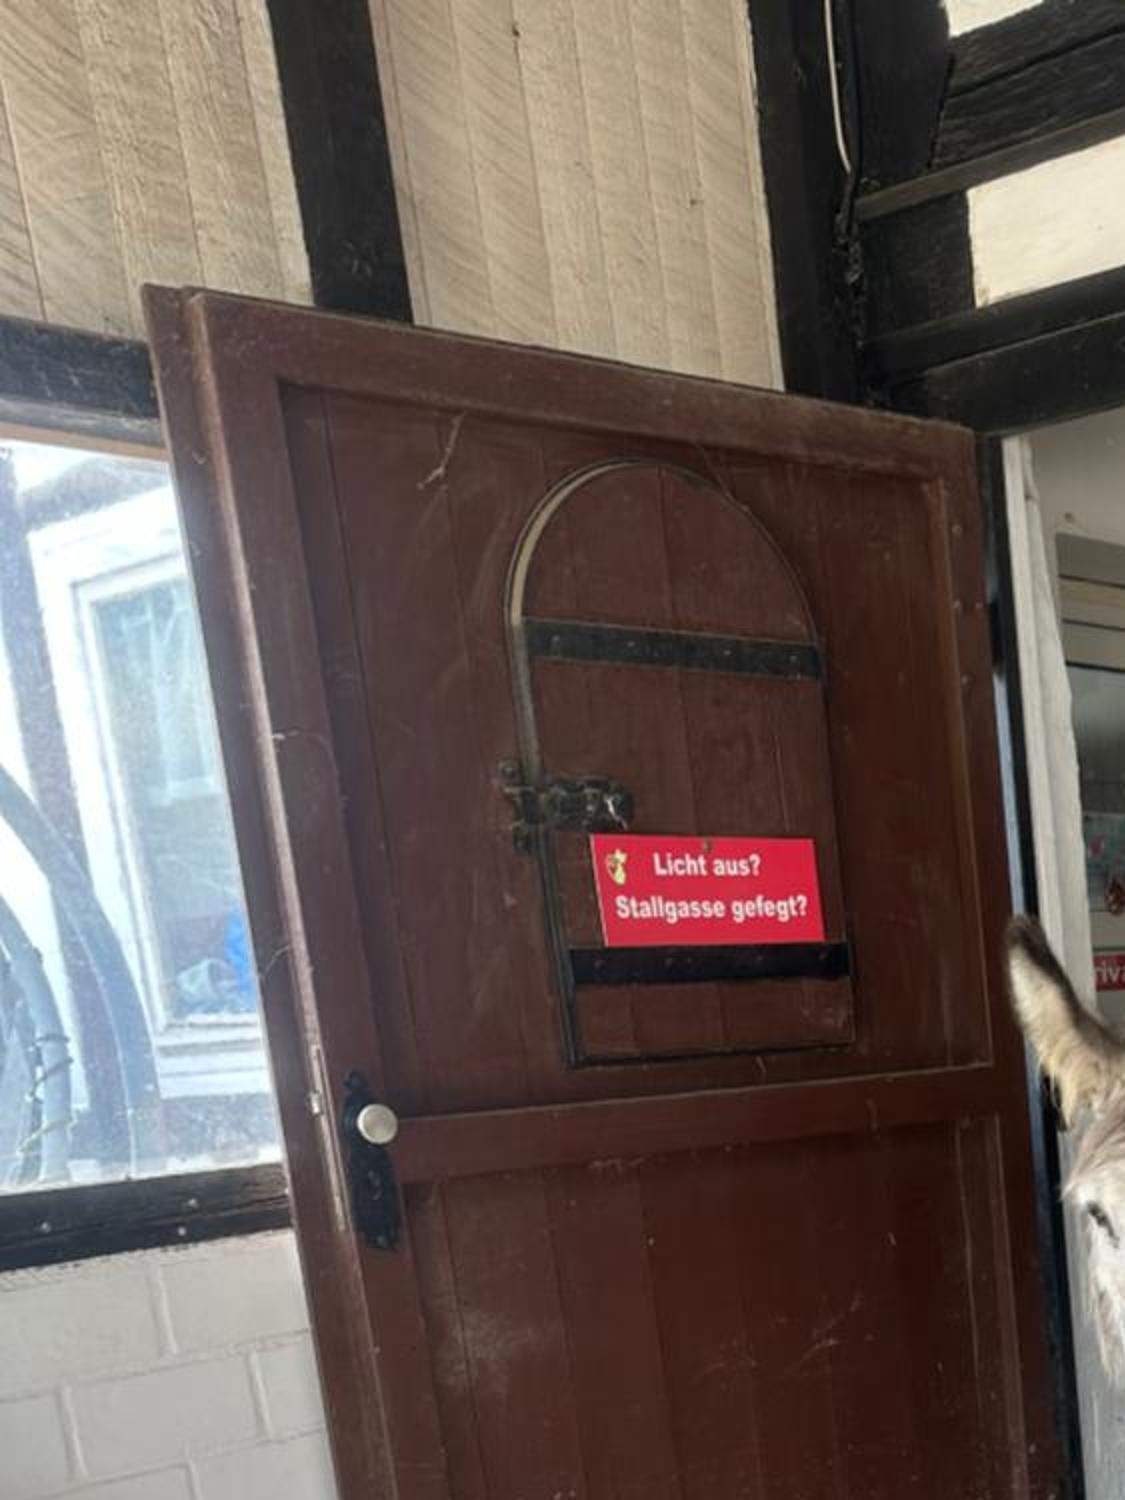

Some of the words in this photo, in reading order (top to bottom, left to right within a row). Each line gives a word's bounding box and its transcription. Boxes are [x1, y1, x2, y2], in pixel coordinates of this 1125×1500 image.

[653, 852, 708, 877] Licht
[712, 853, 761, 877] aus?
[615, 895, 726, 924] Stallgasse
[731, 895, 808, 923] gefegt?
